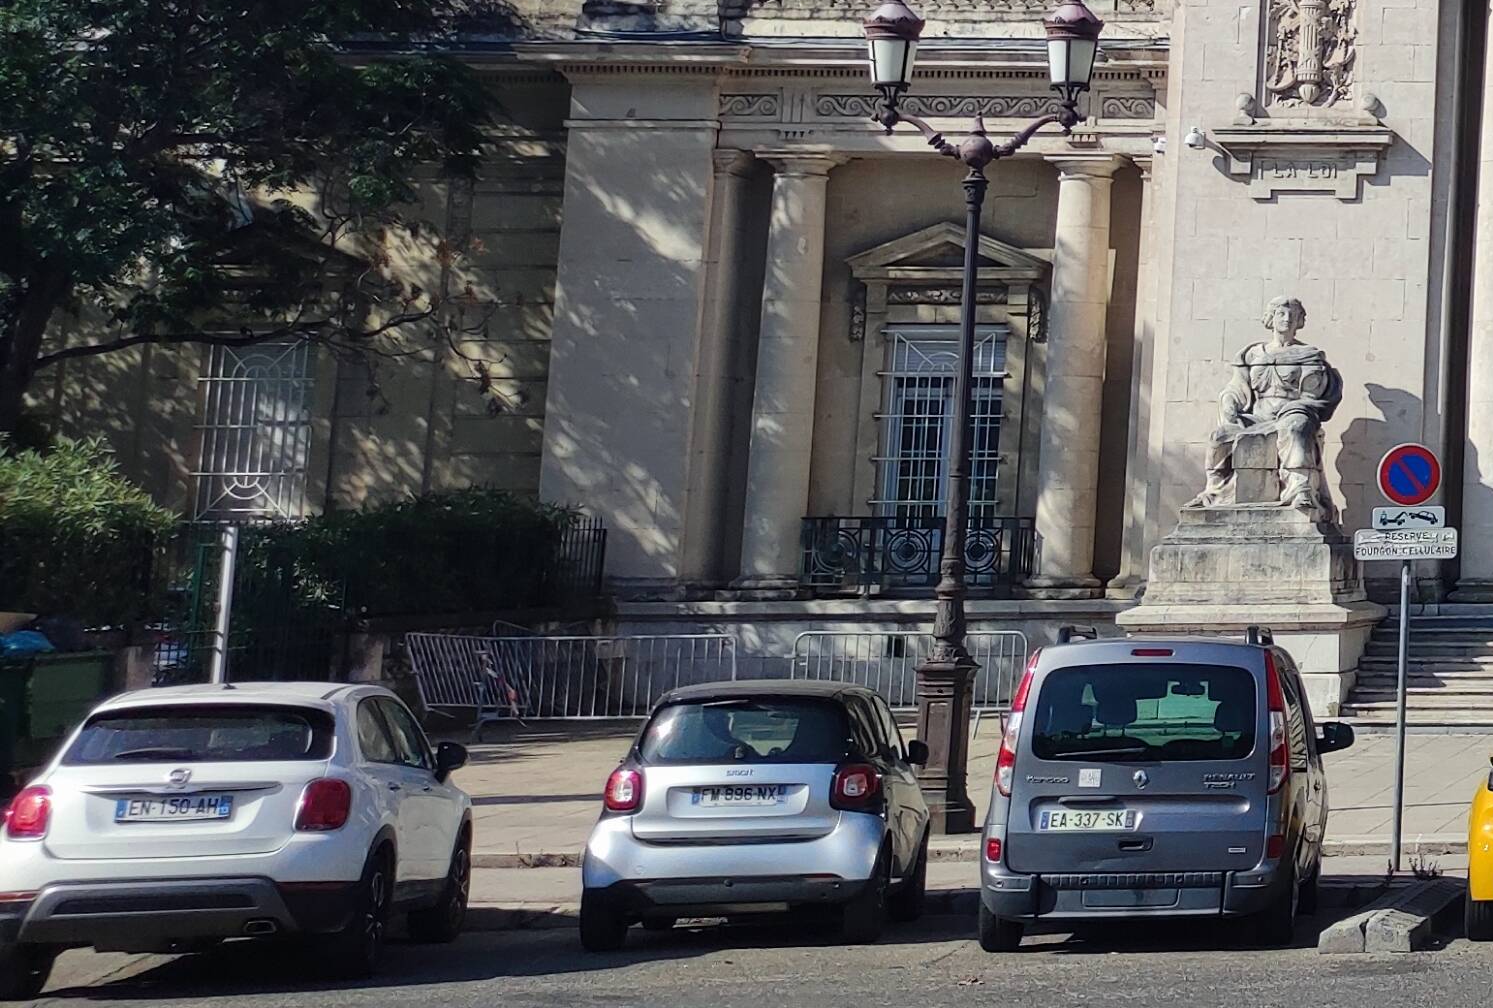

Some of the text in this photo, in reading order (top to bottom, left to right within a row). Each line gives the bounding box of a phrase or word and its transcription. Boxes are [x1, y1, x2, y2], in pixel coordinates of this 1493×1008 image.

[1356, 545, 1456, 557] FOURGON CELLULAIRE
[1050, 812, 1124, 828] EA-337-SK
